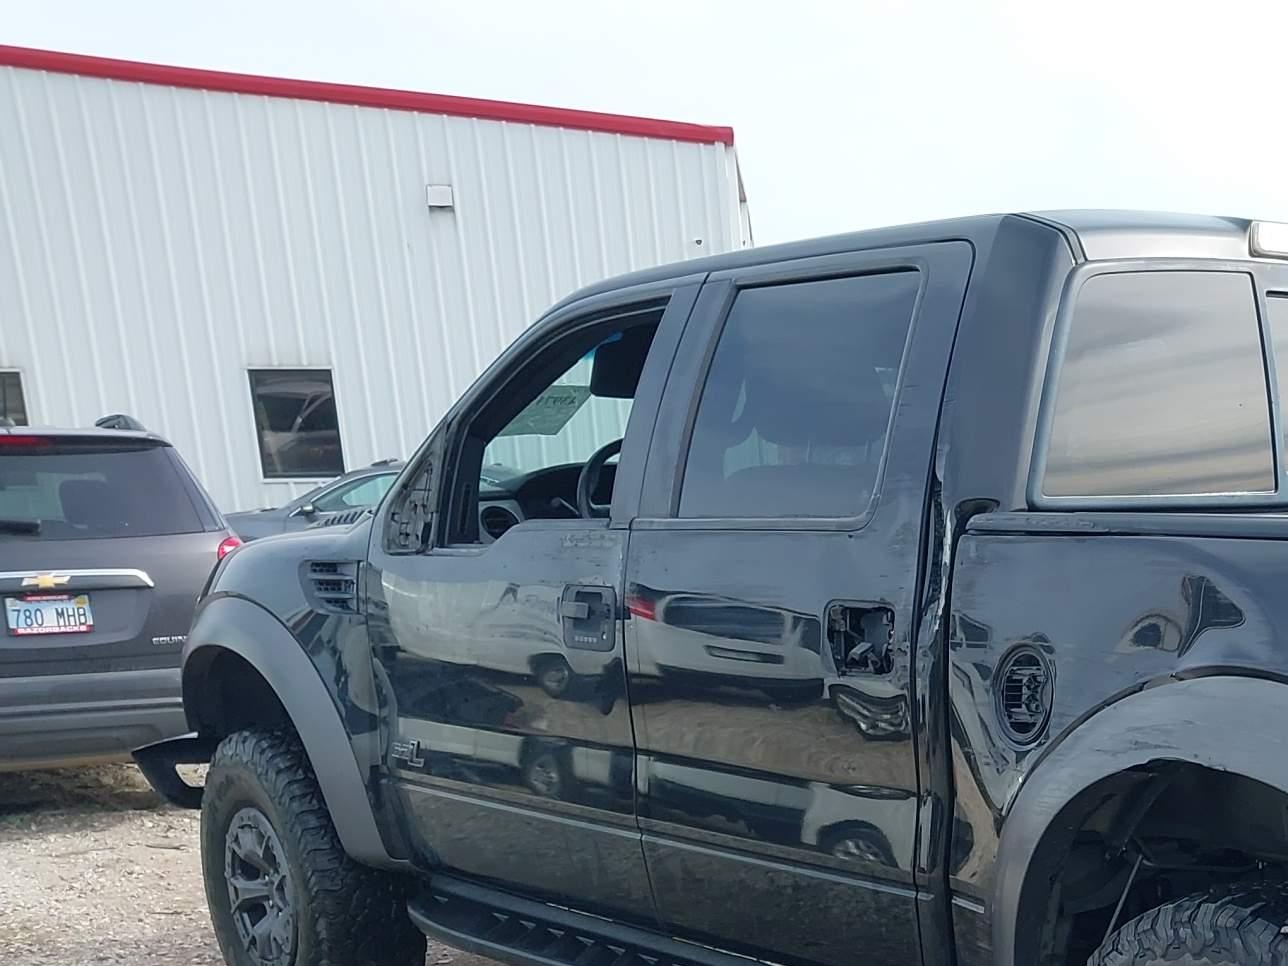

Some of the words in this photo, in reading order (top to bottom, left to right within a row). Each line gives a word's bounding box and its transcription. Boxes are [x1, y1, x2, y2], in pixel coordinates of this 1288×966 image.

[11, 607, 45, 628] 780
[55, 606, 88, 627] MHB
[16, 625, 88, 635] RAZORBACKS
